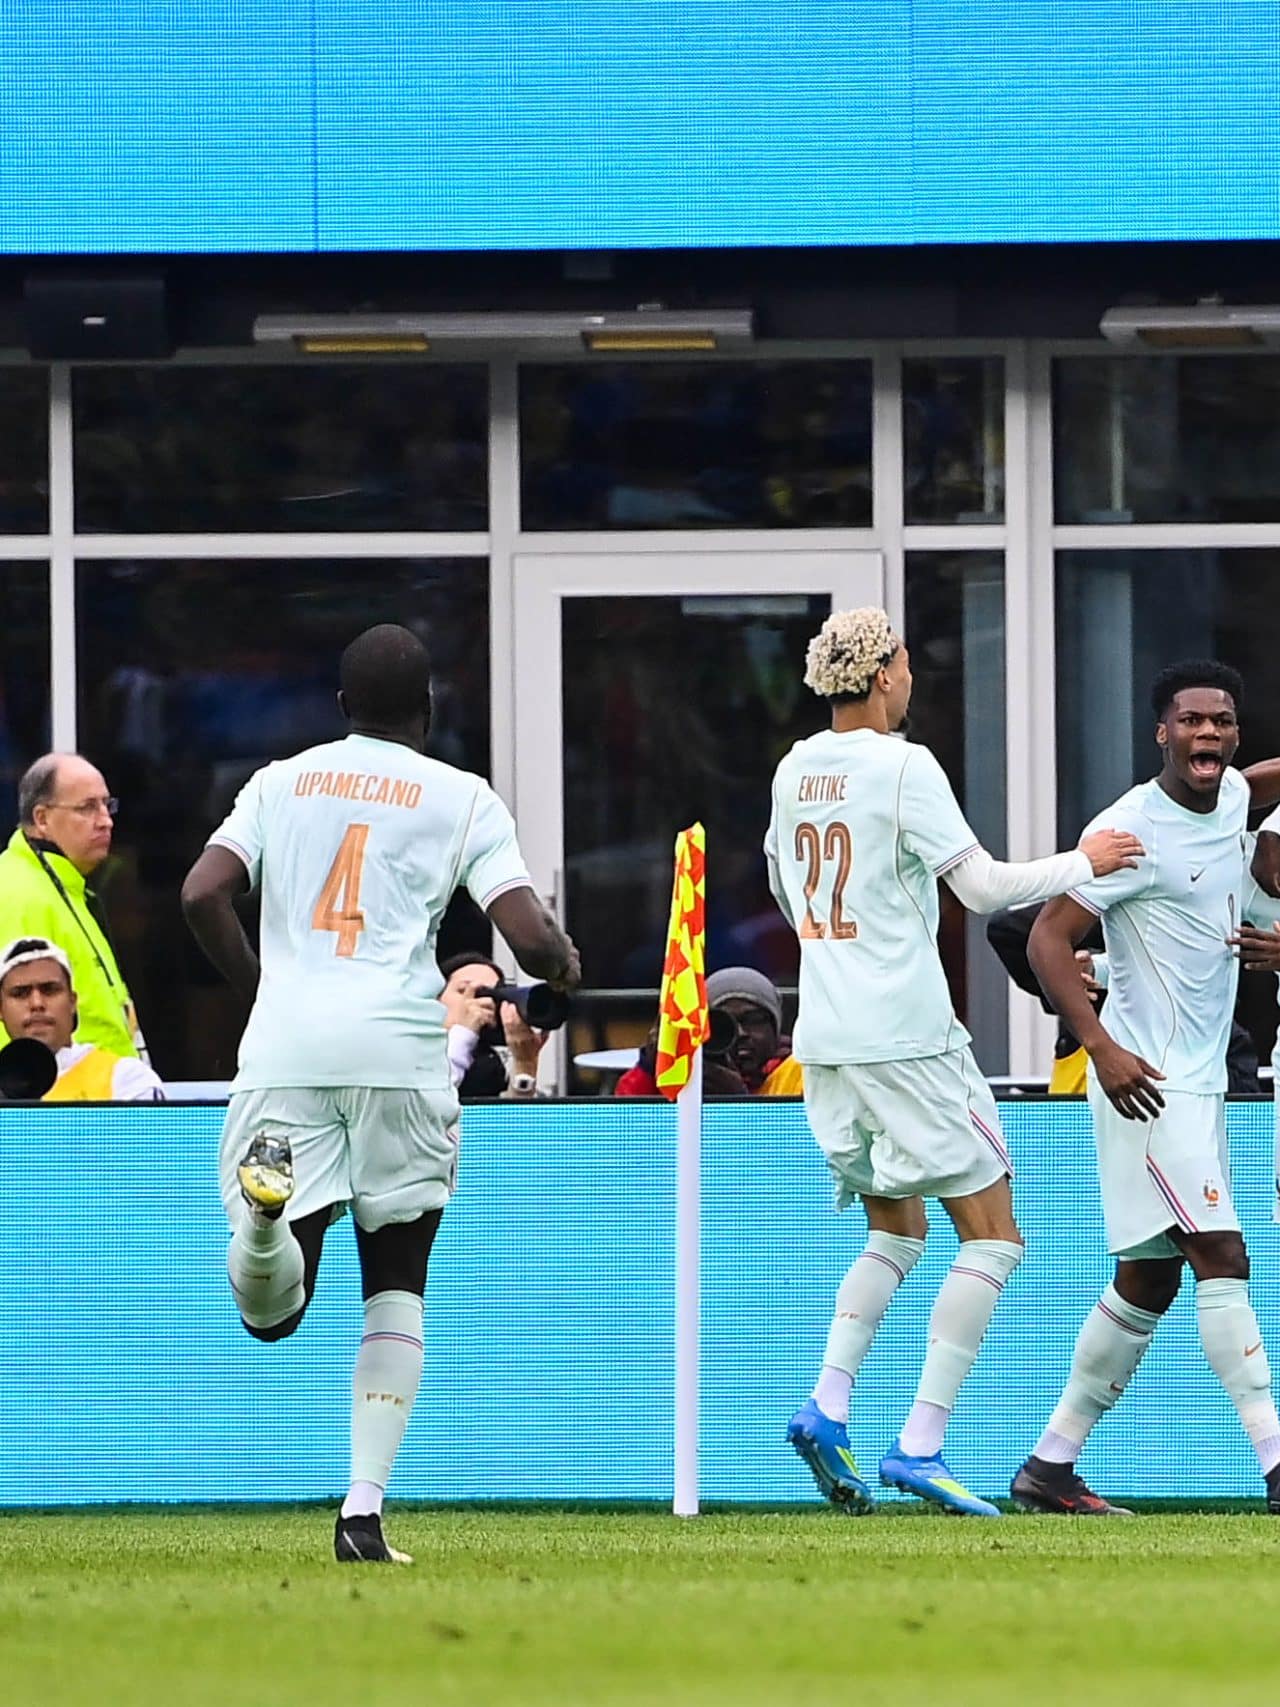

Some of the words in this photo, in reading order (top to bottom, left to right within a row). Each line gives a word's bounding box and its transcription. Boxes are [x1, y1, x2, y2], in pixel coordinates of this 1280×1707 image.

[294, 771, 422, 809] UPAMECANO
[798, 775, 848, 802] EKITIKE
[312, 823, 369, 957] 4
[795, 821, 857, 939] 22
